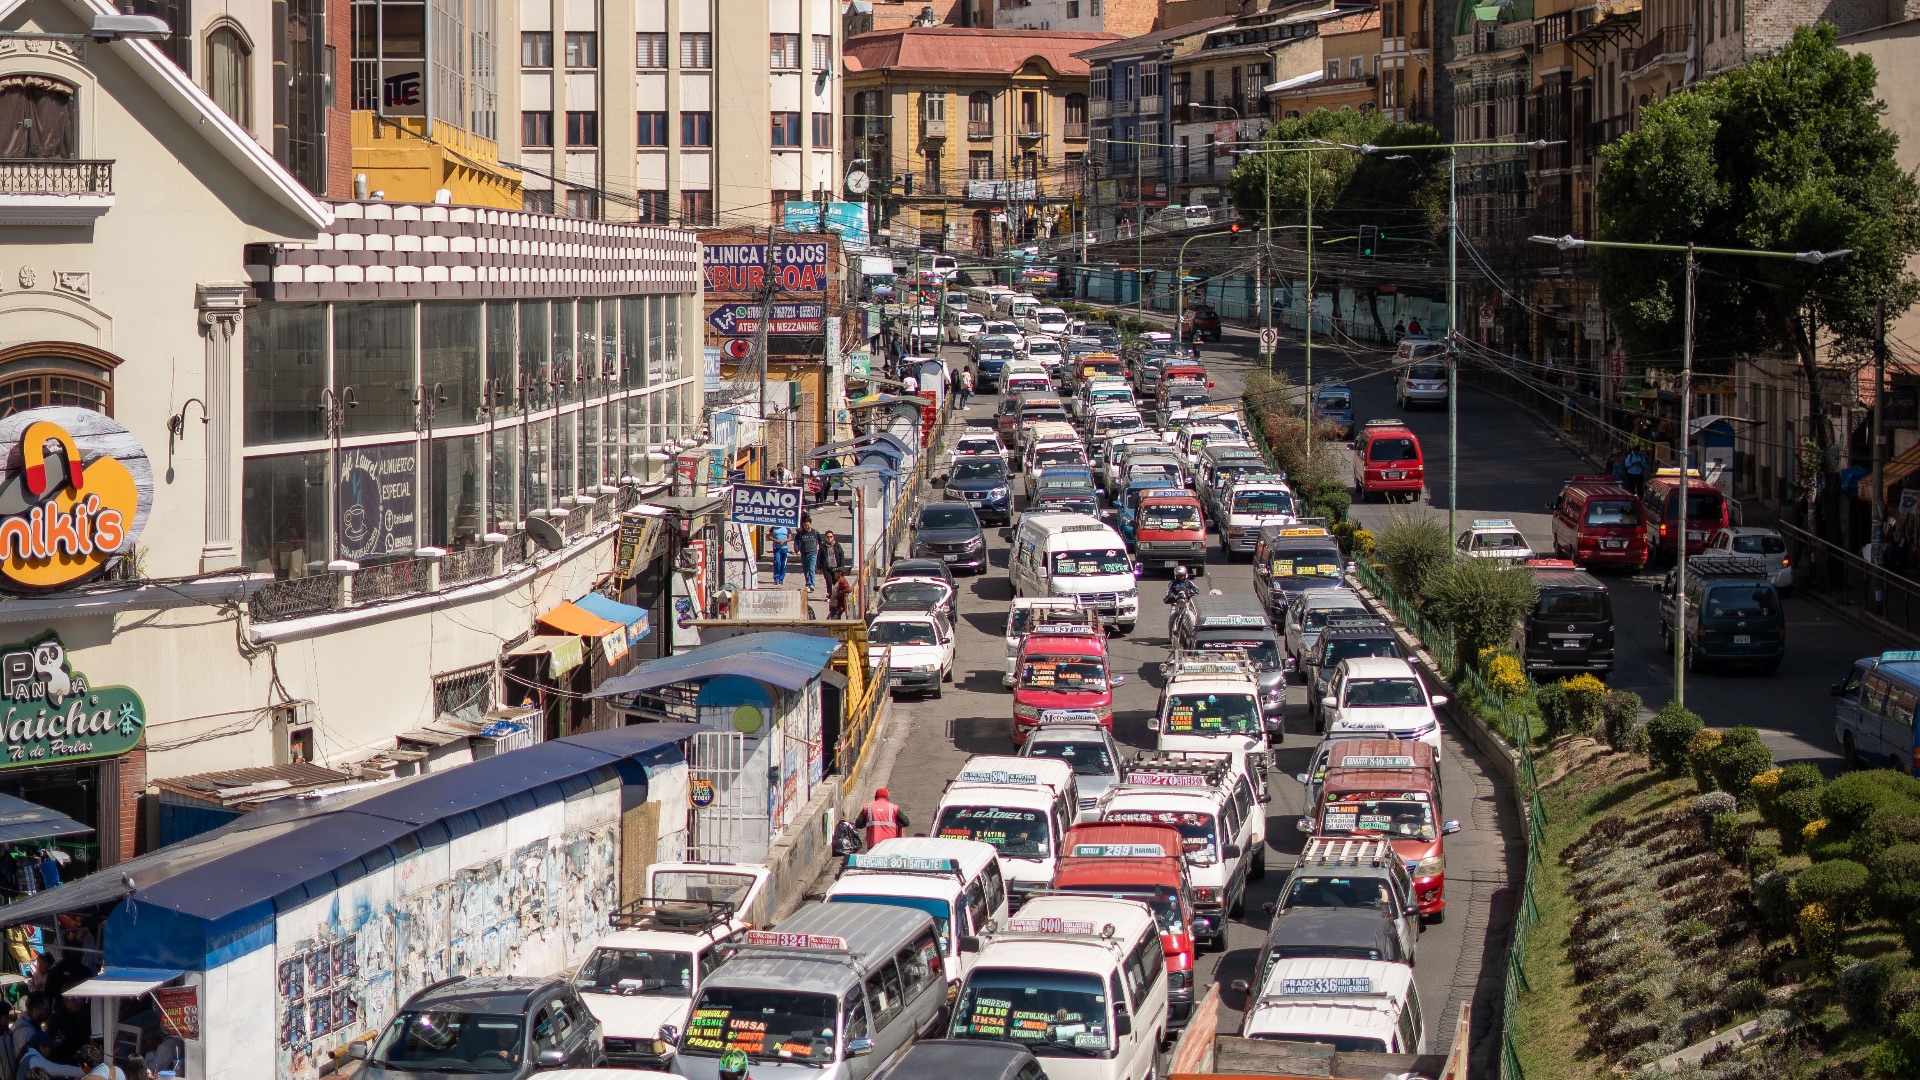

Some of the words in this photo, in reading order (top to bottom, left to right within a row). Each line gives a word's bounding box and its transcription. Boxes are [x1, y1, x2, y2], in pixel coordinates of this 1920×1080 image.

[703, 246, 759, 264] CLINICA
[786, 245, 825, 263] OJOS
[380, 456, 415, 475] ALMUERZO
[382, 481, 411, 500] ESPECIAL
[735, 488, 797, 508] BAÑO
[734, 503, 796, 518] PÚBLICO
[755, 516, 777, 524] HIGIENE
[29, 745, 44, 757] de
[51, 738, 94, 755] Perlas
[992, 771, 1008, 783] 890
[1152, 776, 1177, 785] 270
[1105, 846, 1131, 856] 289
[890, 858, 907, 868] 801
[909, 859, 939, 869] SATELITE
[1041, 918, 1061, 933] 900
[780, 934, 807, 947] 324
[1283, 986, 1296, 994] SAN
[1315, 978, 1336, 993] 336
[975, 1006, 1008, 1016] PRADO
[730, 1019, 766, 1031] UMSA
[972, 1015, 1006, 1026] UMSA
[737, 1031, 765, 1041] AGOSTO
[979, 1026, 1004, 1035] AGOSTO
[687, 1037, 723, 1049] PRADO
[782, 1043, 813, 1056] AMERICAS
